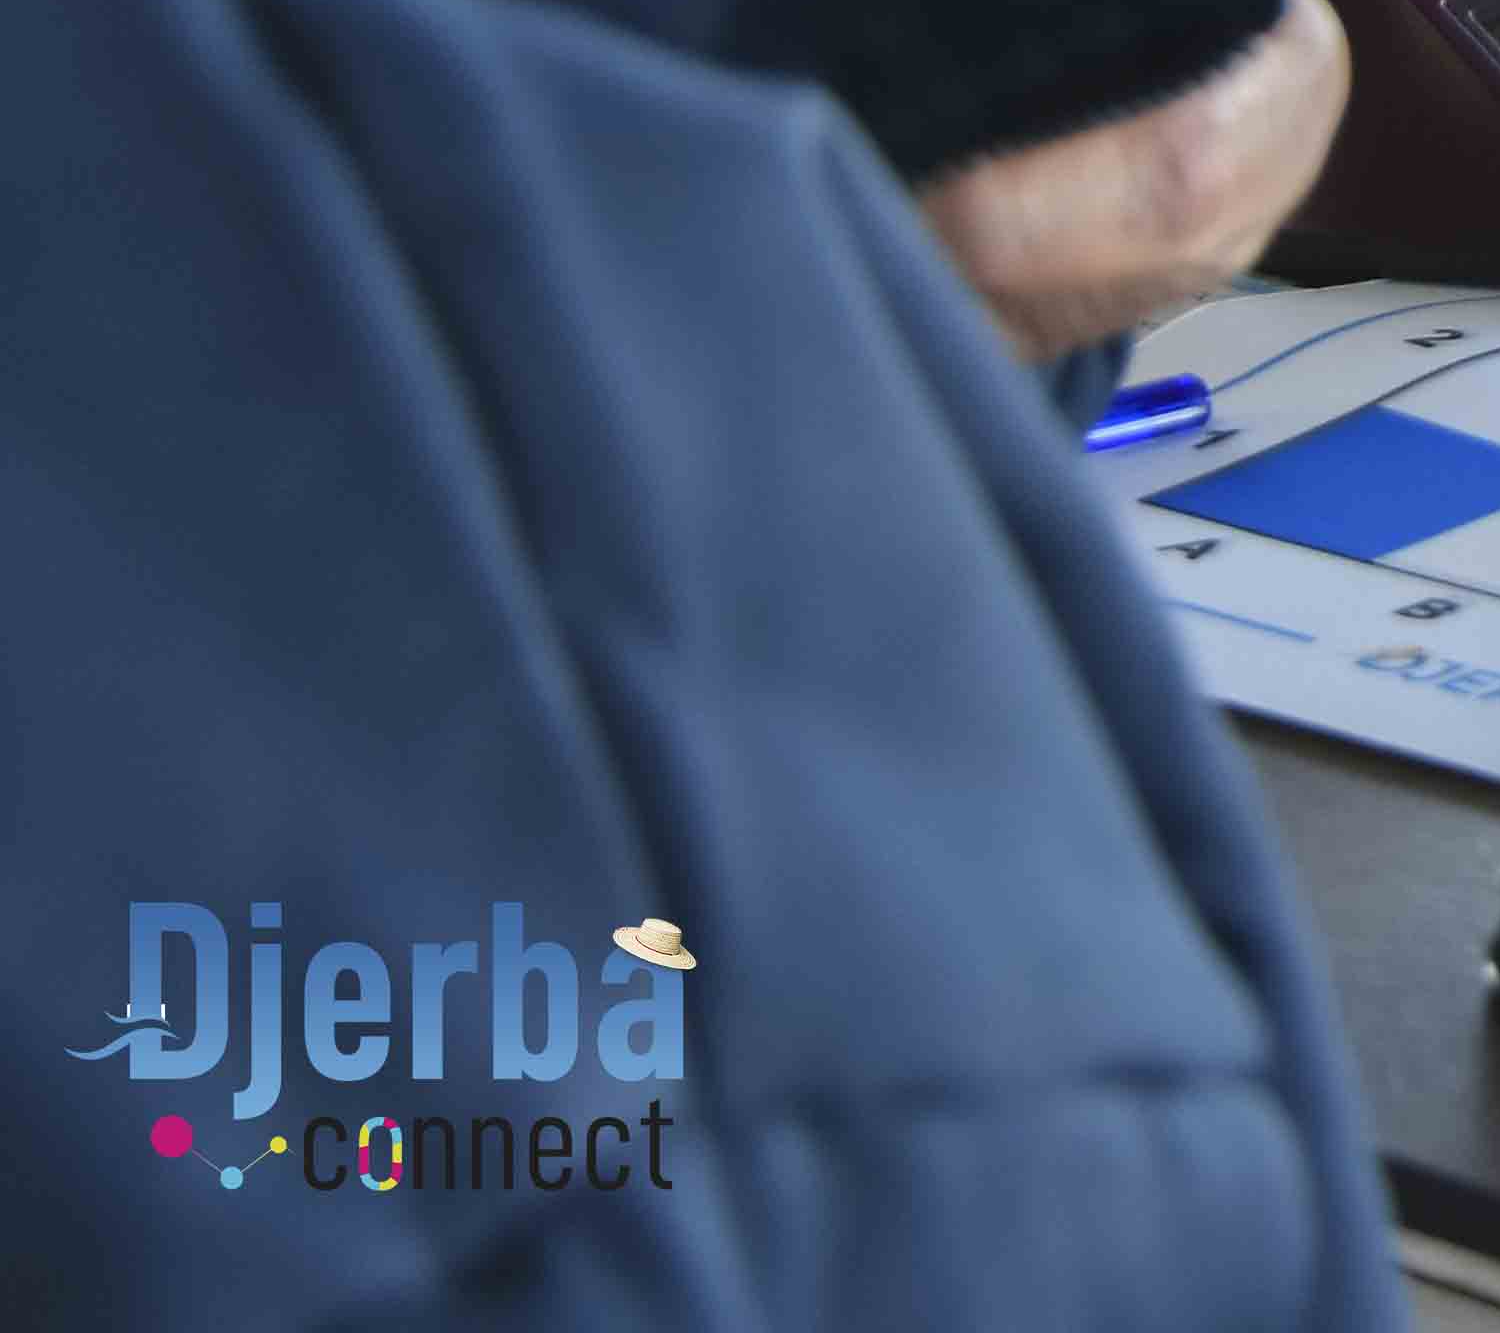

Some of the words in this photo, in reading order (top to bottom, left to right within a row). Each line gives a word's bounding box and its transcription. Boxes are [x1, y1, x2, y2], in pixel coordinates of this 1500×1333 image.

[1405, 326, 1464, 349] 2
[1157, 537, 1223, 560] A
[1393, 595, 1461, 620] B
